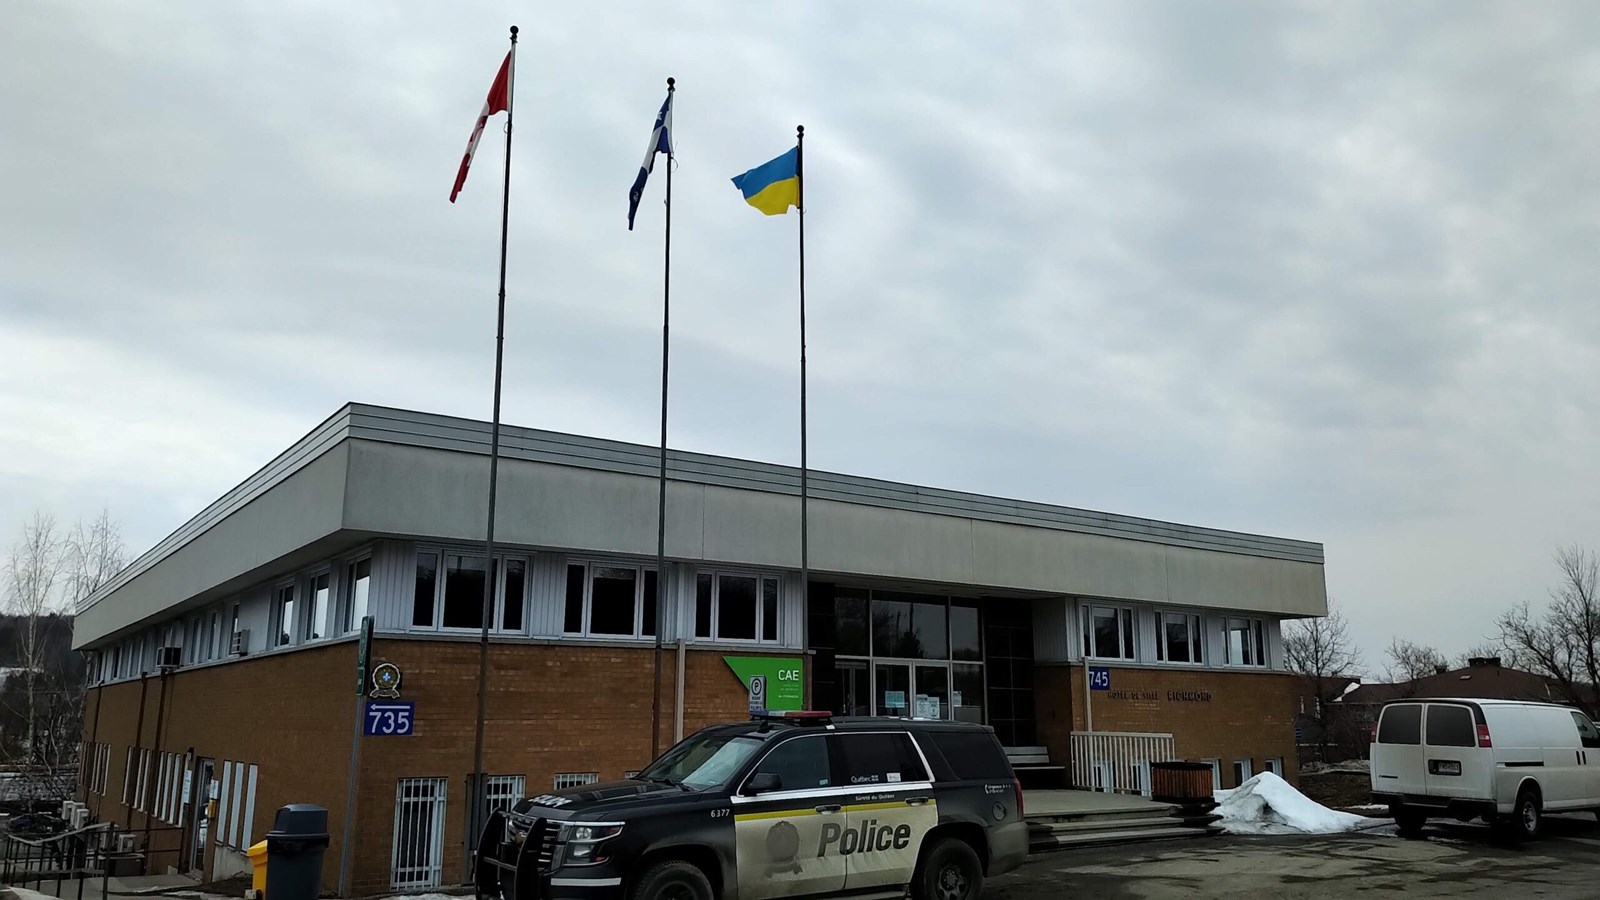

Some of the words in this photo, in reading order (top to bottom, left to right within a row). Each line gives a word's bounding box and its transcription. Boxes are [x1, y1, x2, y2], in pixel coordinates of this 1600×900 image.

[778, 669, 799, 681] CAE
[1089, 671, 1109, 687] 745
[1167, 690, 1212, 702] RICHMOND
[369, 711, 409, 734] 735
[851, 775, 871, 783] Québec
[710, 808, 731, 818] 6377
[817, 819, 911, 858] Police
